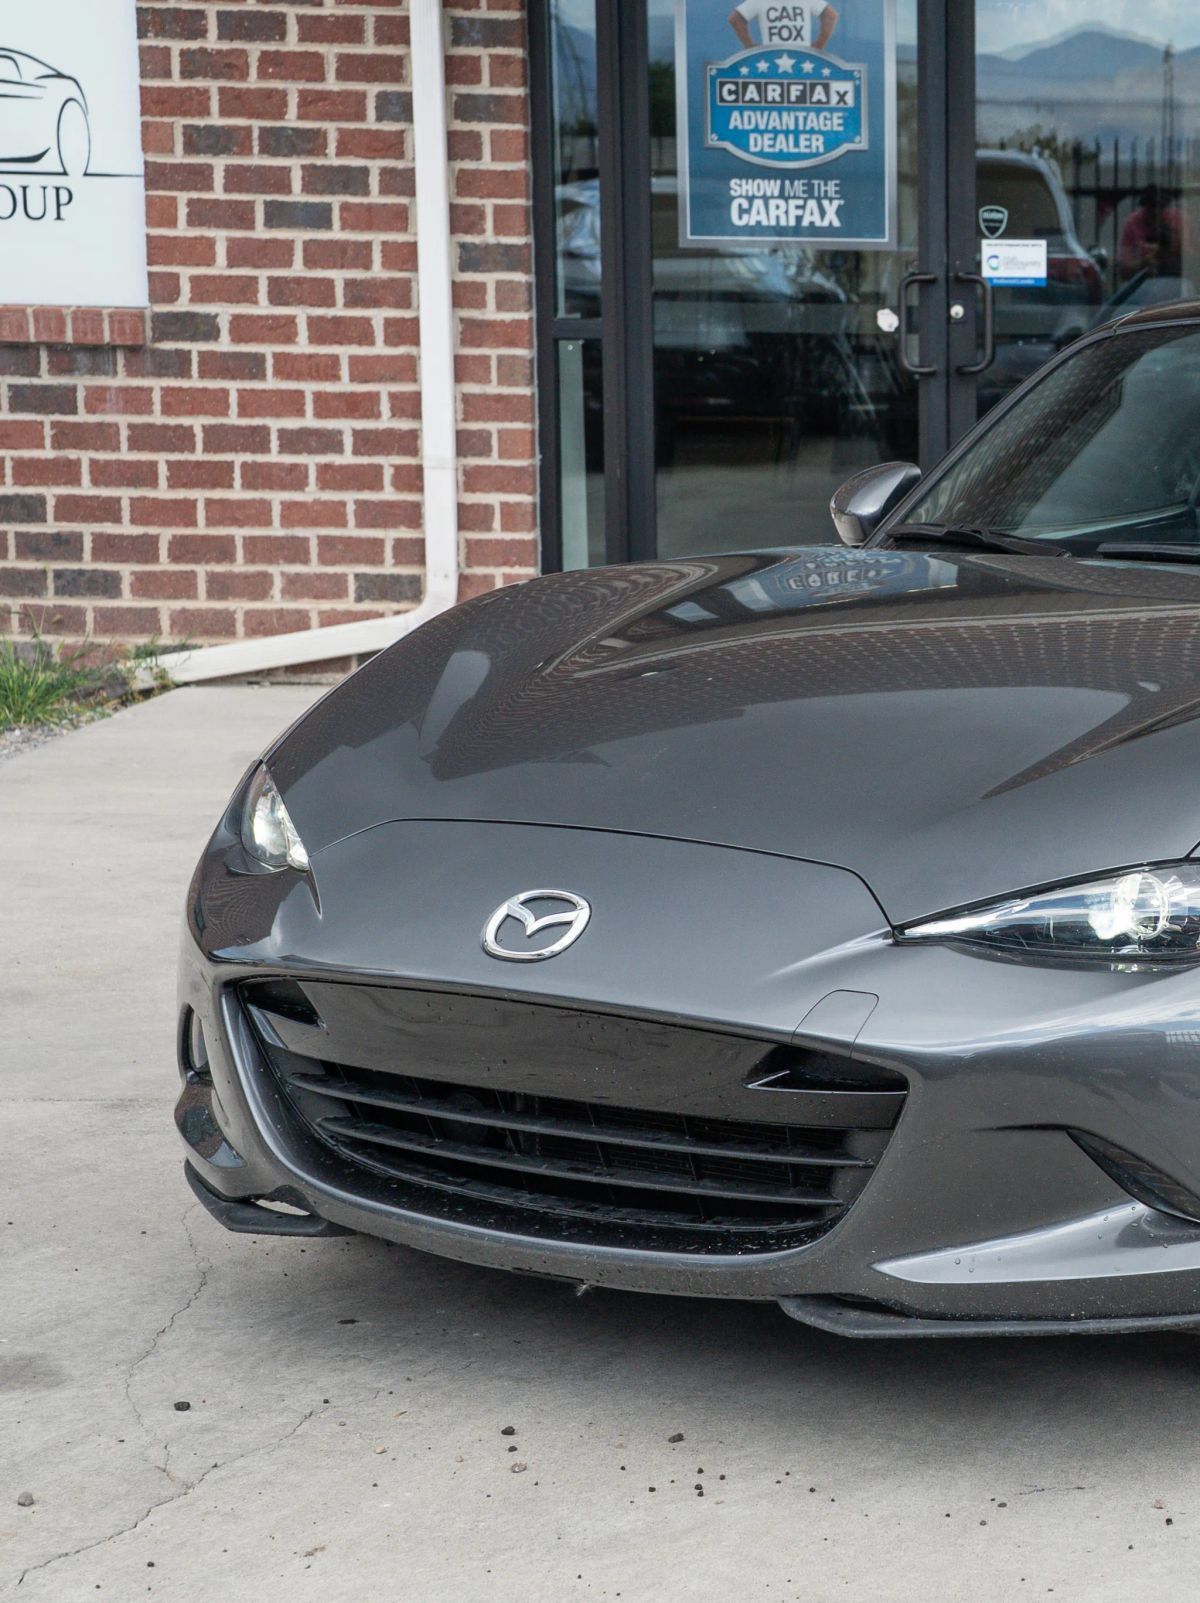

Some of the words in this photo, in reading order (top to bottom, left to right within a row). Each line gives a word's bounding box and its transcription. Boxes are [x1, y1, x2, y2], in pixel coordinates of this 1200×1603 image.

[766, 6, 804, 23] CAR
[768, 25, 804, 42] FOX
[720, 82, 850, 106] CARFAX
[730, 111, 844, 131] ADVANTAGE
[749, 133, 824, 153] DEALER
[730, 178, 780, 197] SHOW
[784, 180, 808, 197] ME
[812, 180, 840, 197] THE
[731, 198, 842, 227] CARFAX
